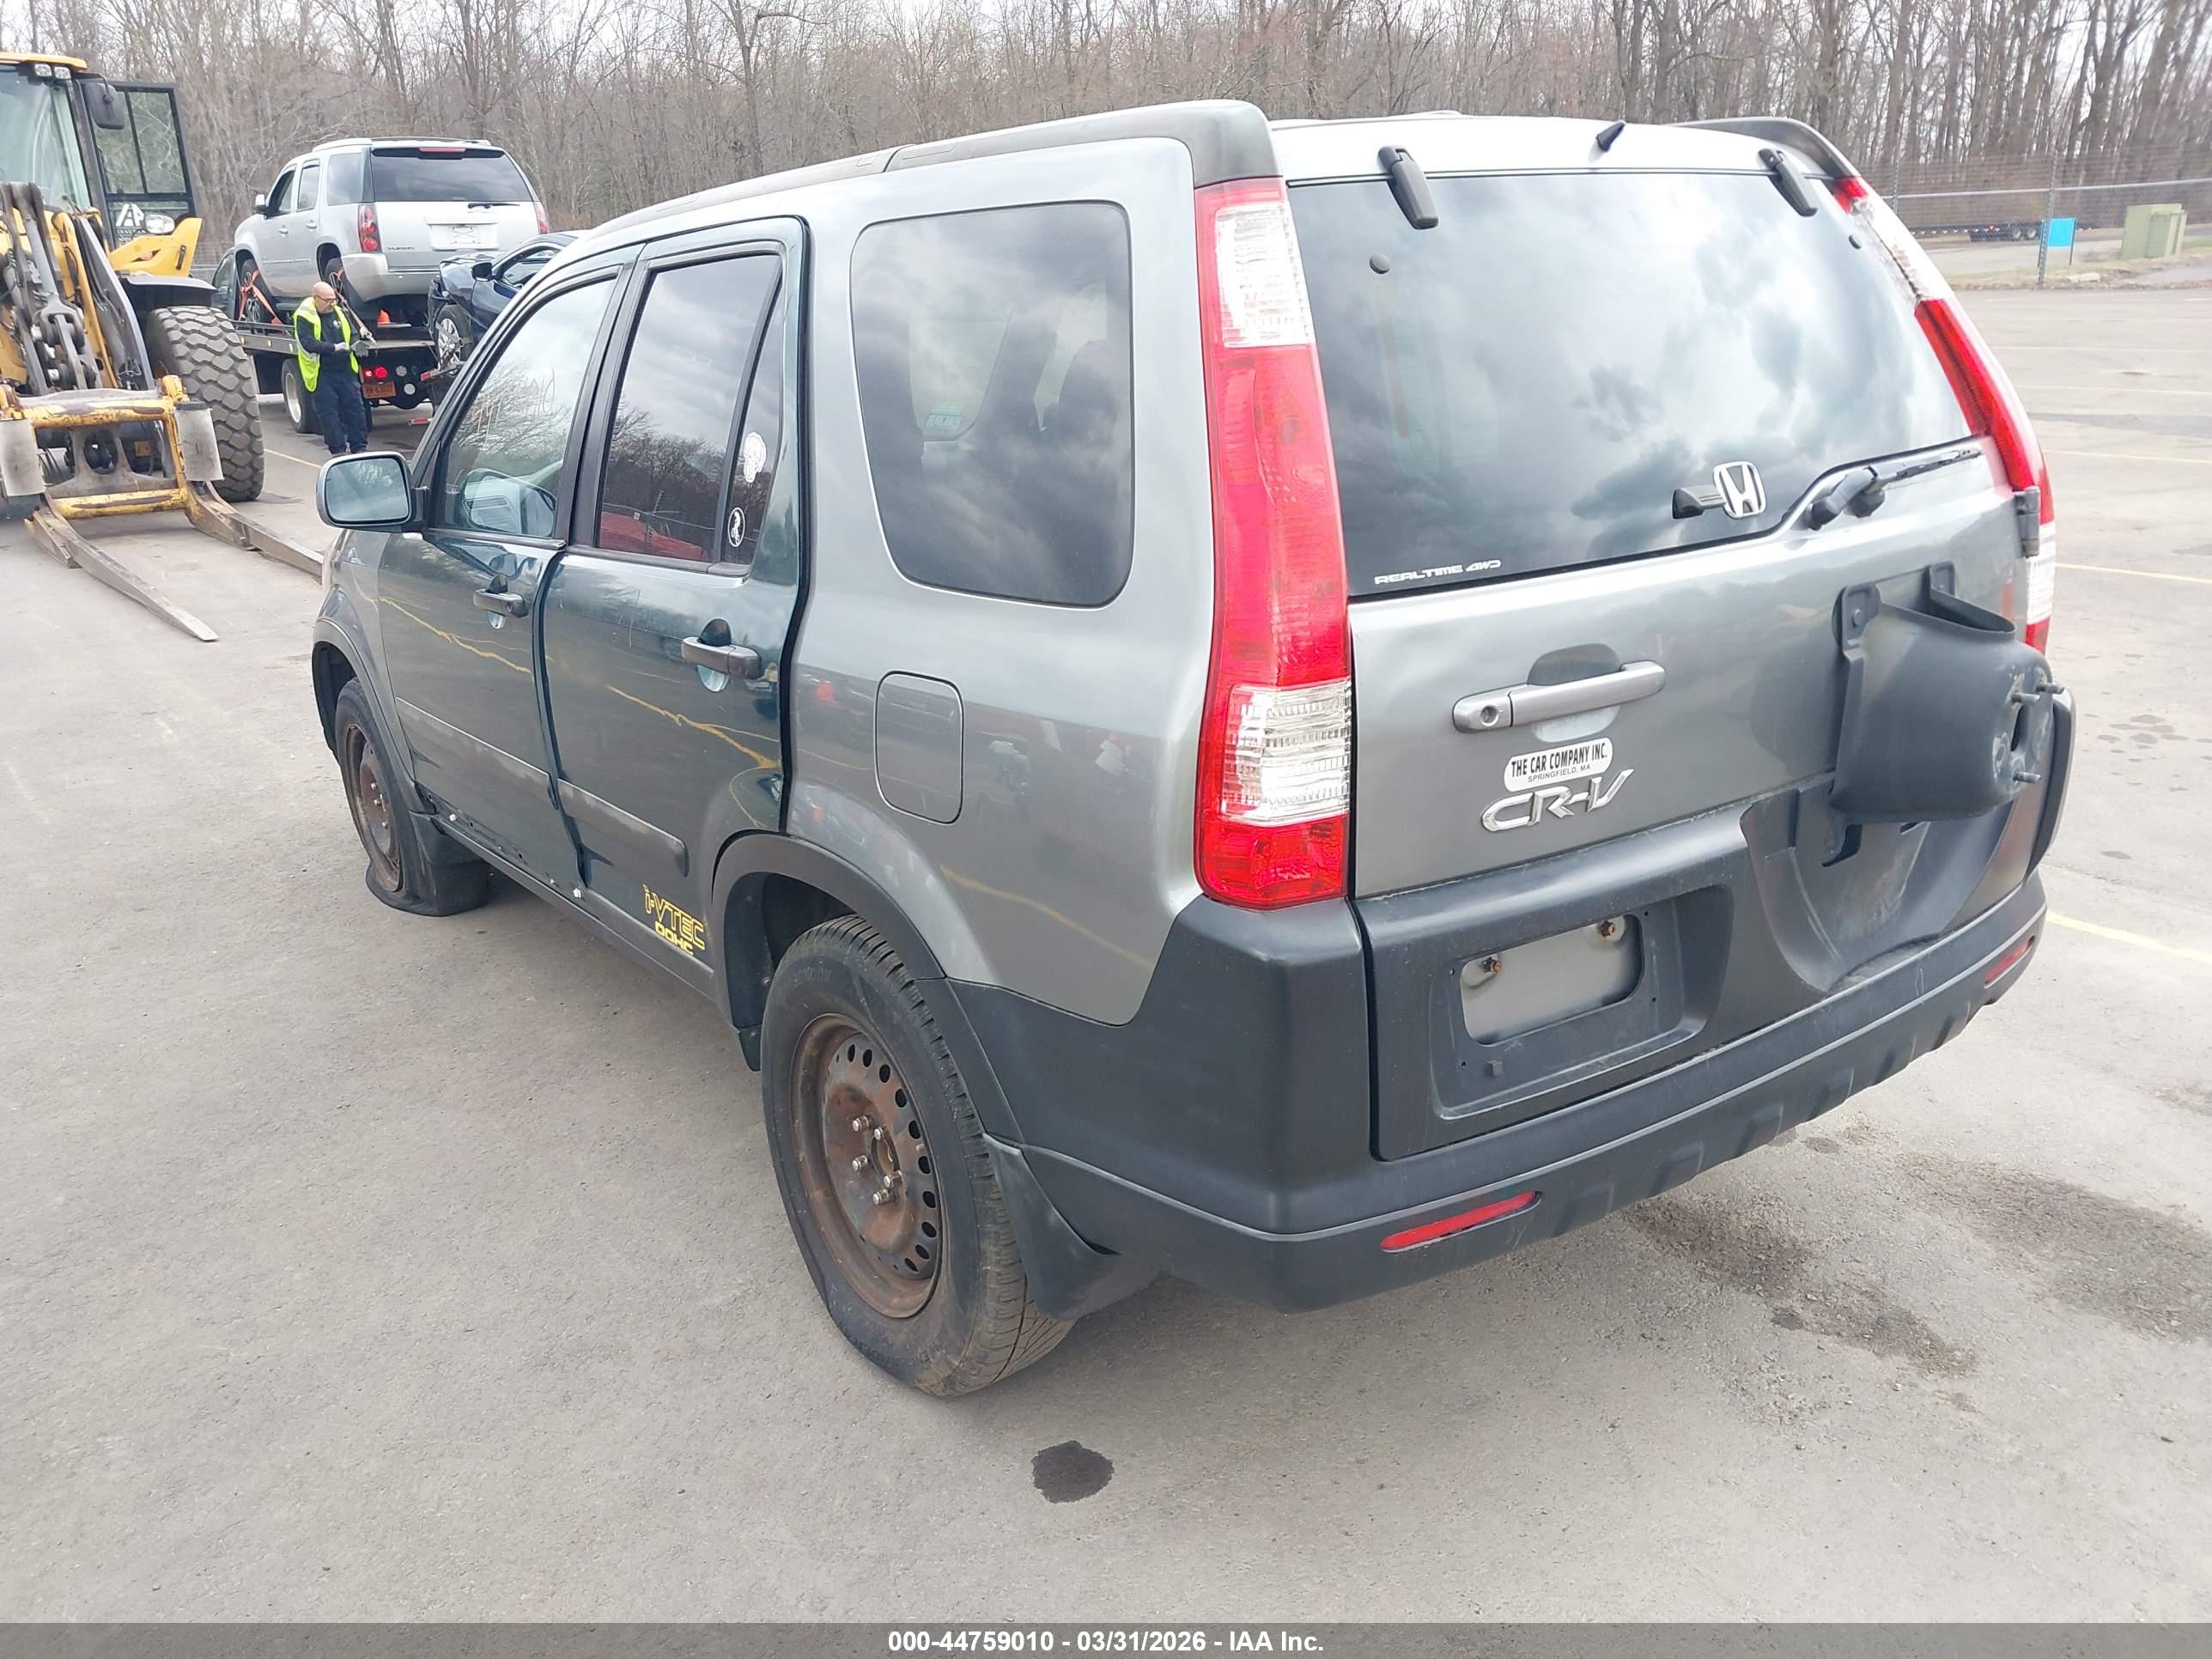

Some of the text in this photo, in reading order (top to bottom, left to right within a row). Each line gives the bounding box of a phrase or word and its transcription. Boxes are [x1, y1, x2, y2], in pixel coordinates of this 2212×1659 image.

[1374, 559, 1502, 584] REALTIME 4WD
[1511, 742, 1607, 778] THE CAR COMPANY INC.
[1528, 763, 1591, 783] SPRINGFIELD, MA
[1480, 769, 1635, 832] CR-V
[654, 921, 694, 956] DOHC
